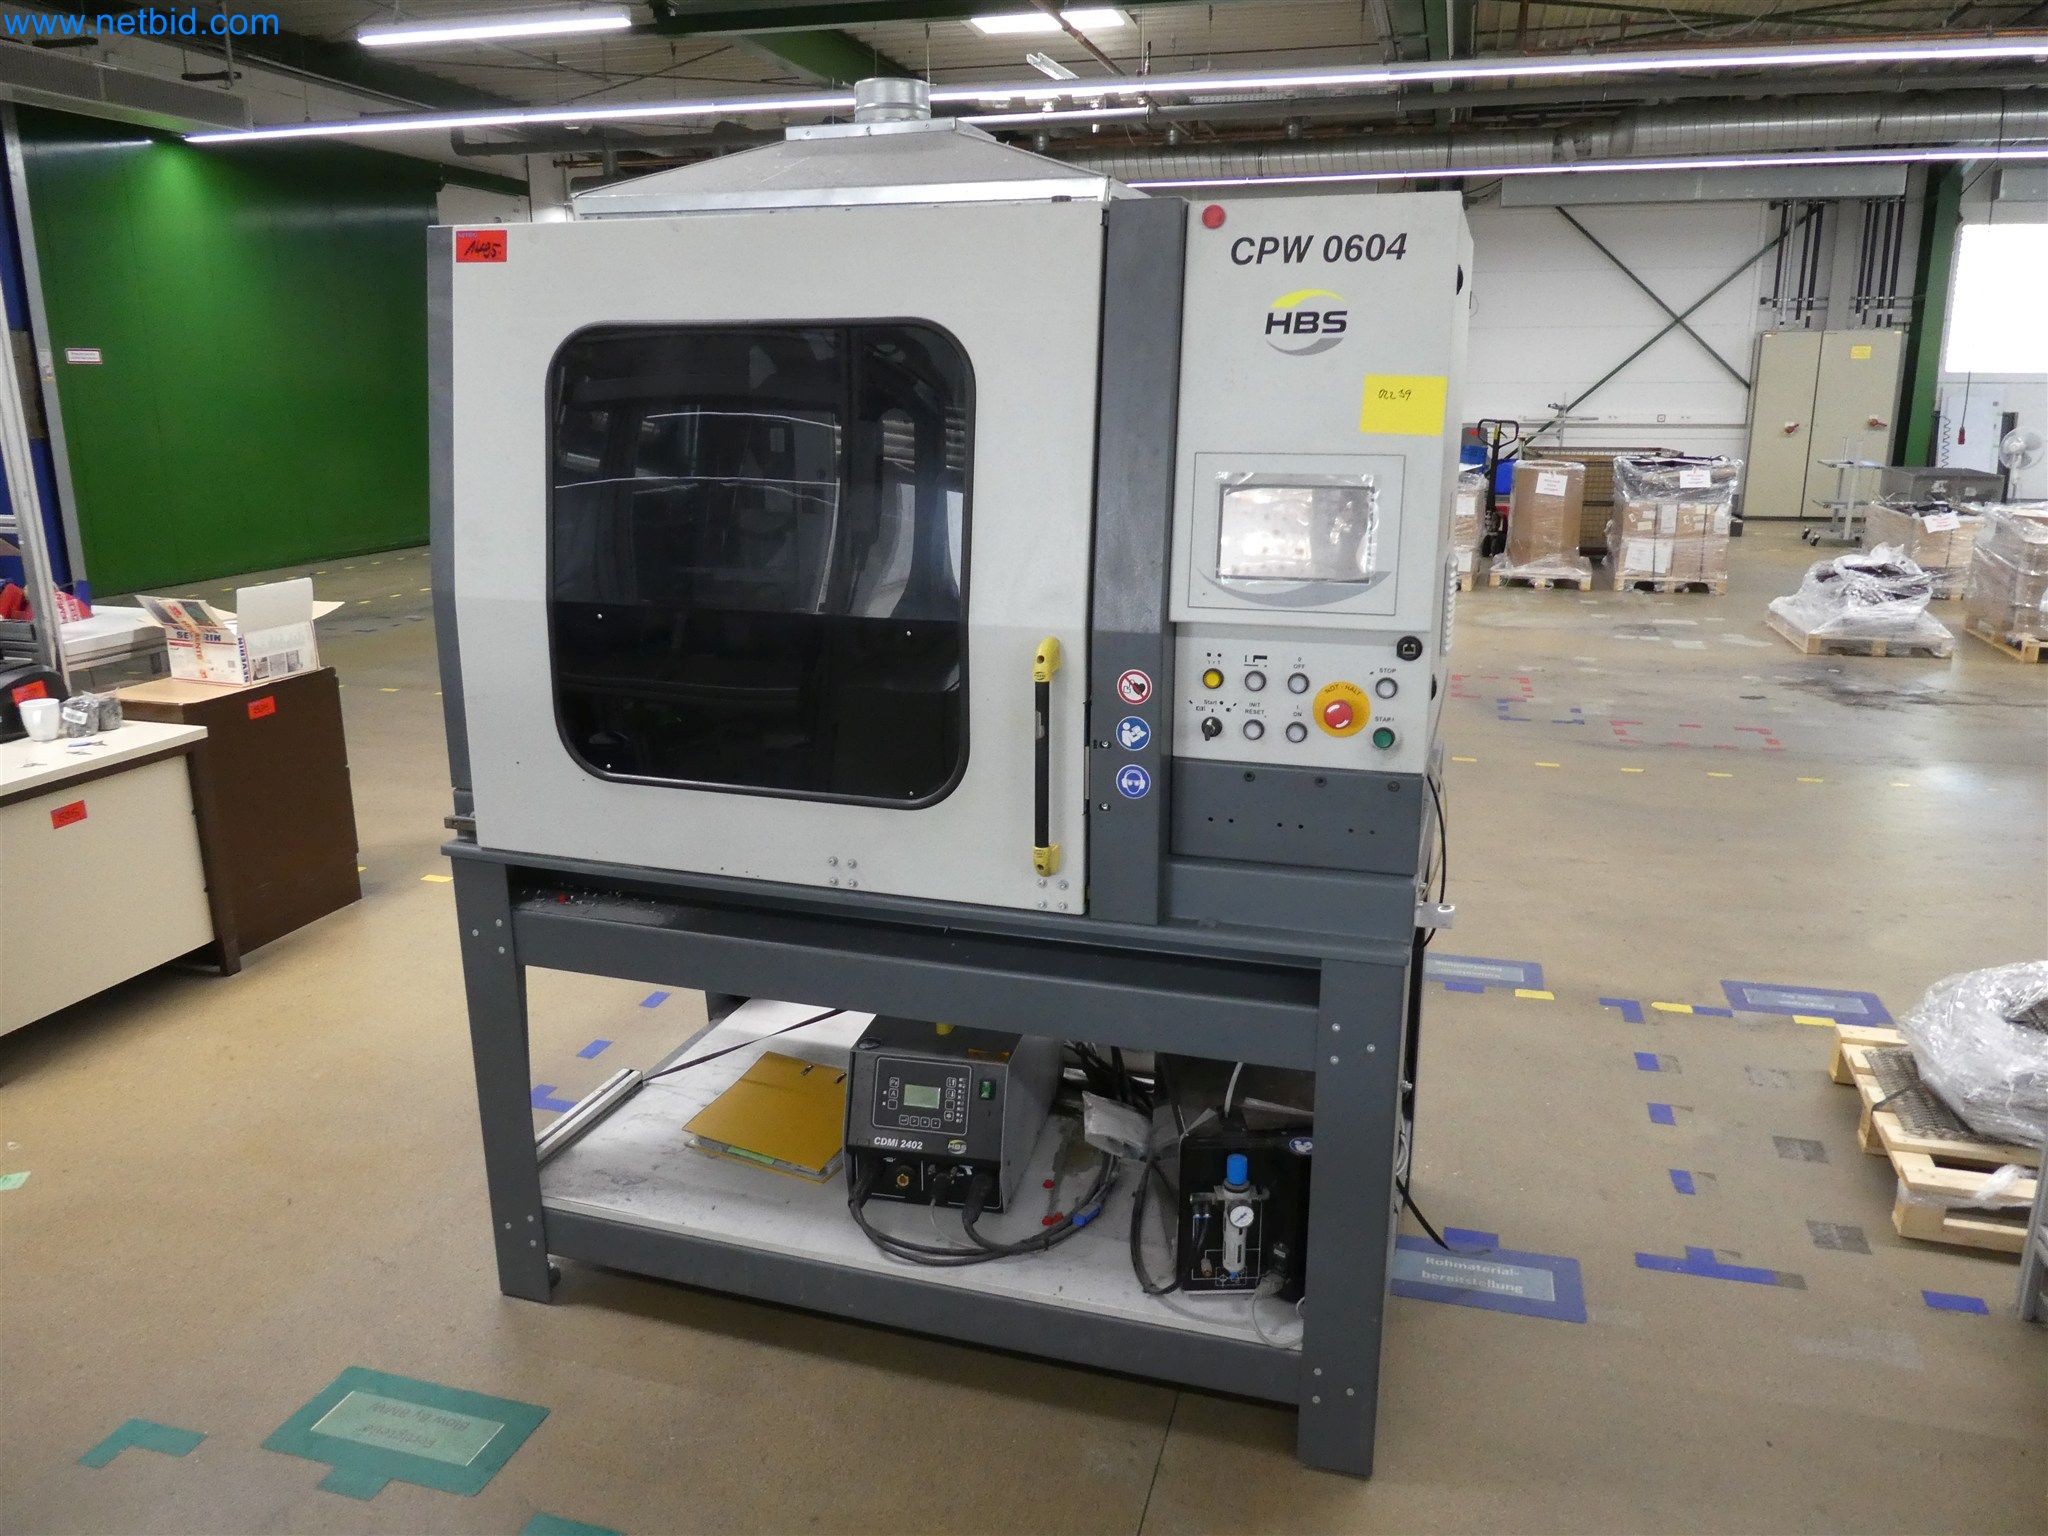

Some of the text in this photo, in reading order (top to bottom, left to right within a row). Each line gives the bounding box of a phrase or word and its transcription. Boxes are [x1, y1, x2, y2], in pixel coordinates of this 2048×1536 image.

[1230, 232, 1408, 266] CPW 0604
[1264, 310, 1348, 335] HBS
[900, 1139, 923, 1150] 2402
